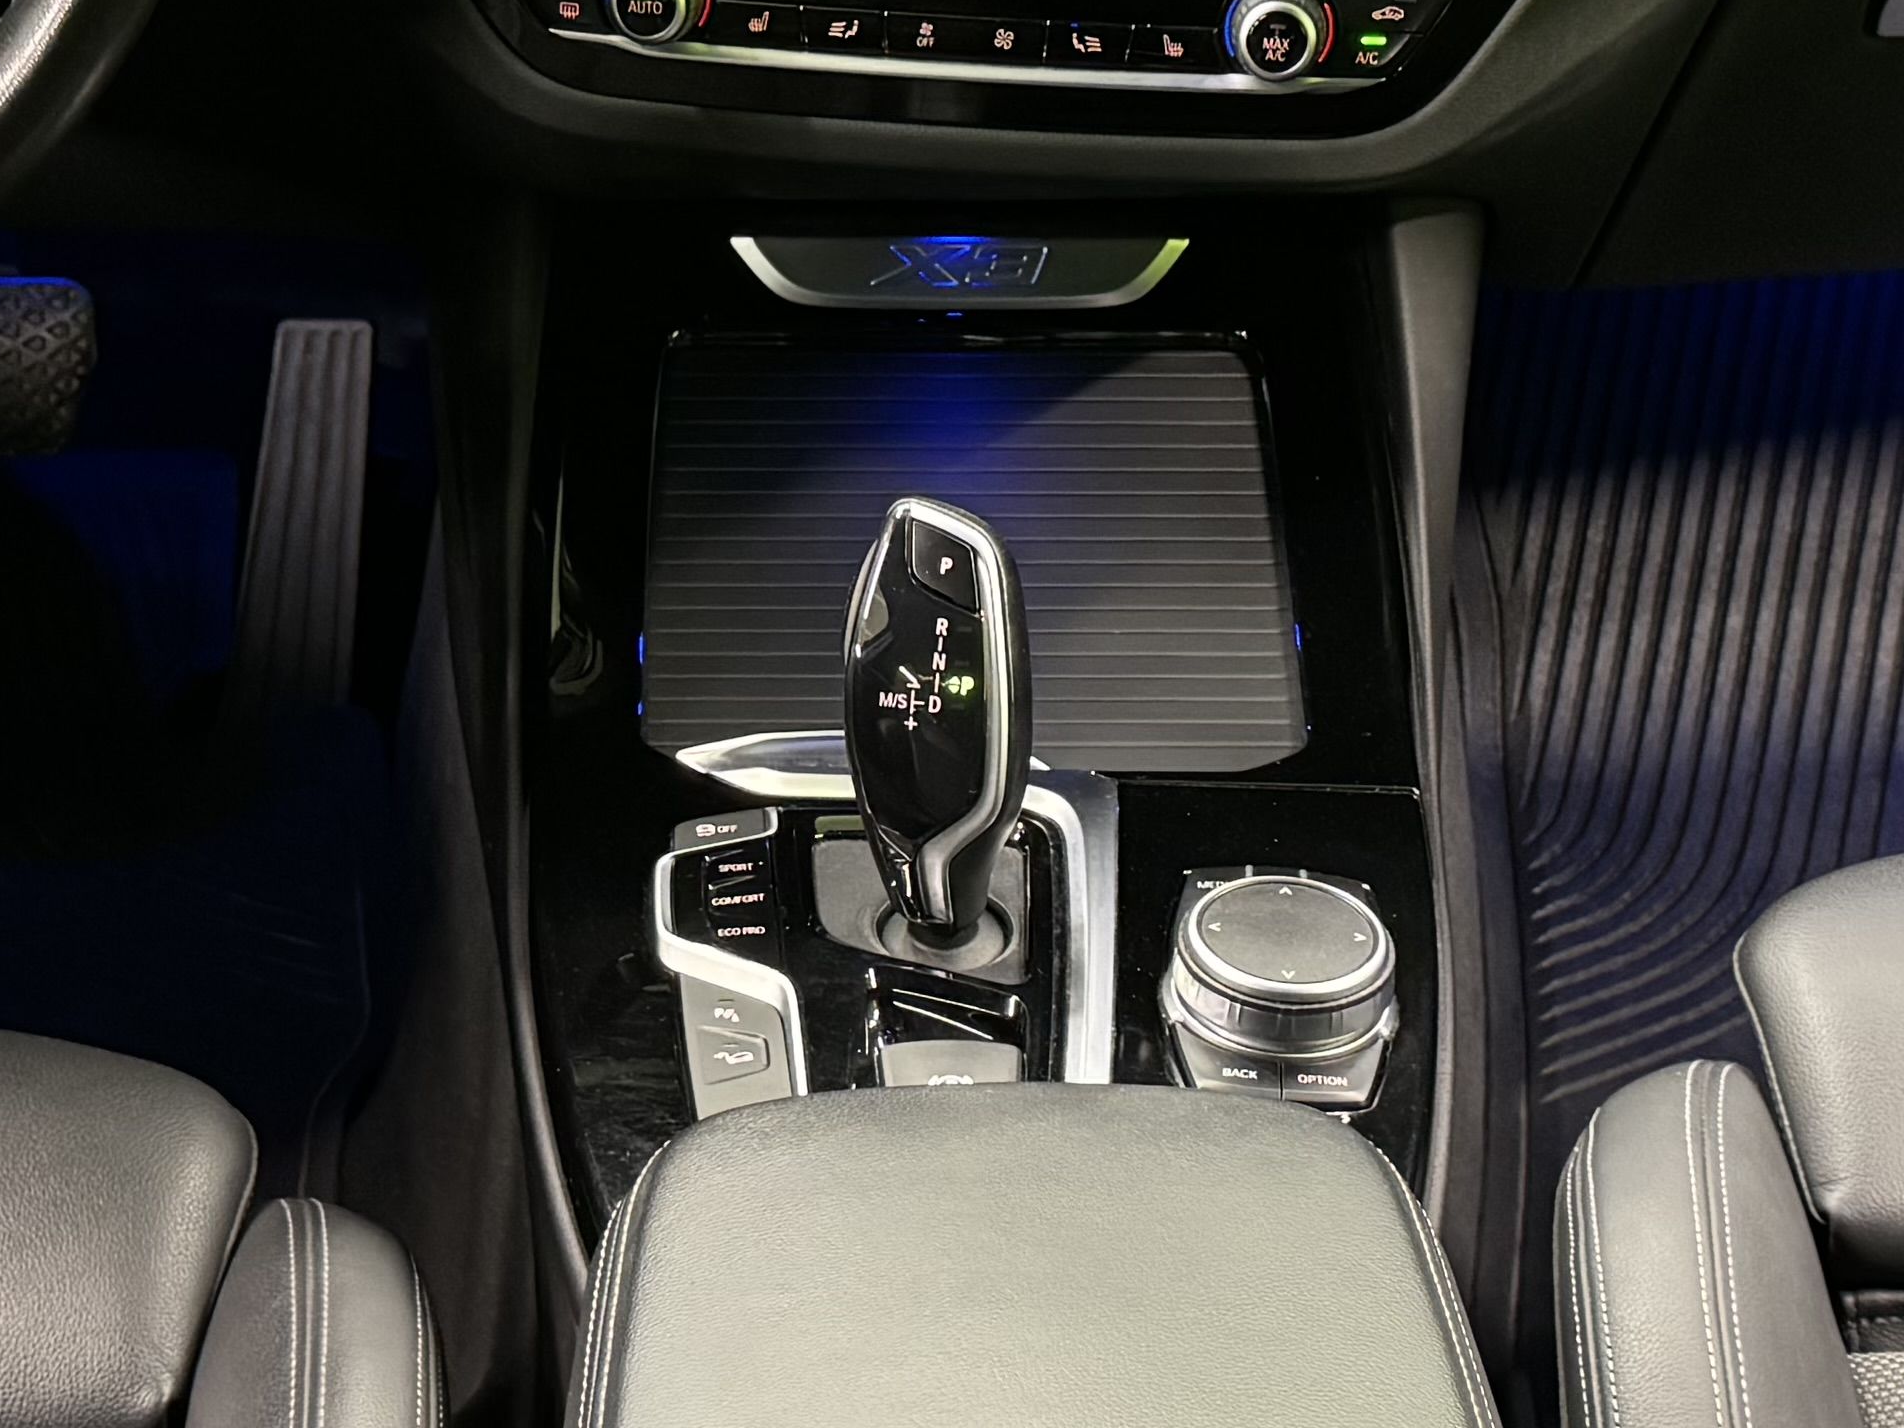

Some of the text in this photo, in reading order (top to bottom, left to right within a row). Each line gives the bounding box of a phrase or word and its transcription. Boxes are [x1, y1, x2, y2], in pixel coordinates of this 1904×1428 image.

[627, 0, 664, 15] AUTO
[916, 37, 936, 49] OFF
[1262, 37, 1290, 51] MAX
[1264, 49, 1287, 63] A/C
[1355, 52, 1379, 66] A/C
[939, 556, 954, 576] P
[935, 617, 950, 637] R
[932, 651, 947, 671] N
[878, 691, 943, 714] M/S D
[718, 862, 754, 873] SPORT
[711, 892, 766, 907] COMFORT
[1222, 1067, 1258, 1080] BACK
[1297, 1073, 1348, 1087] OPTION
